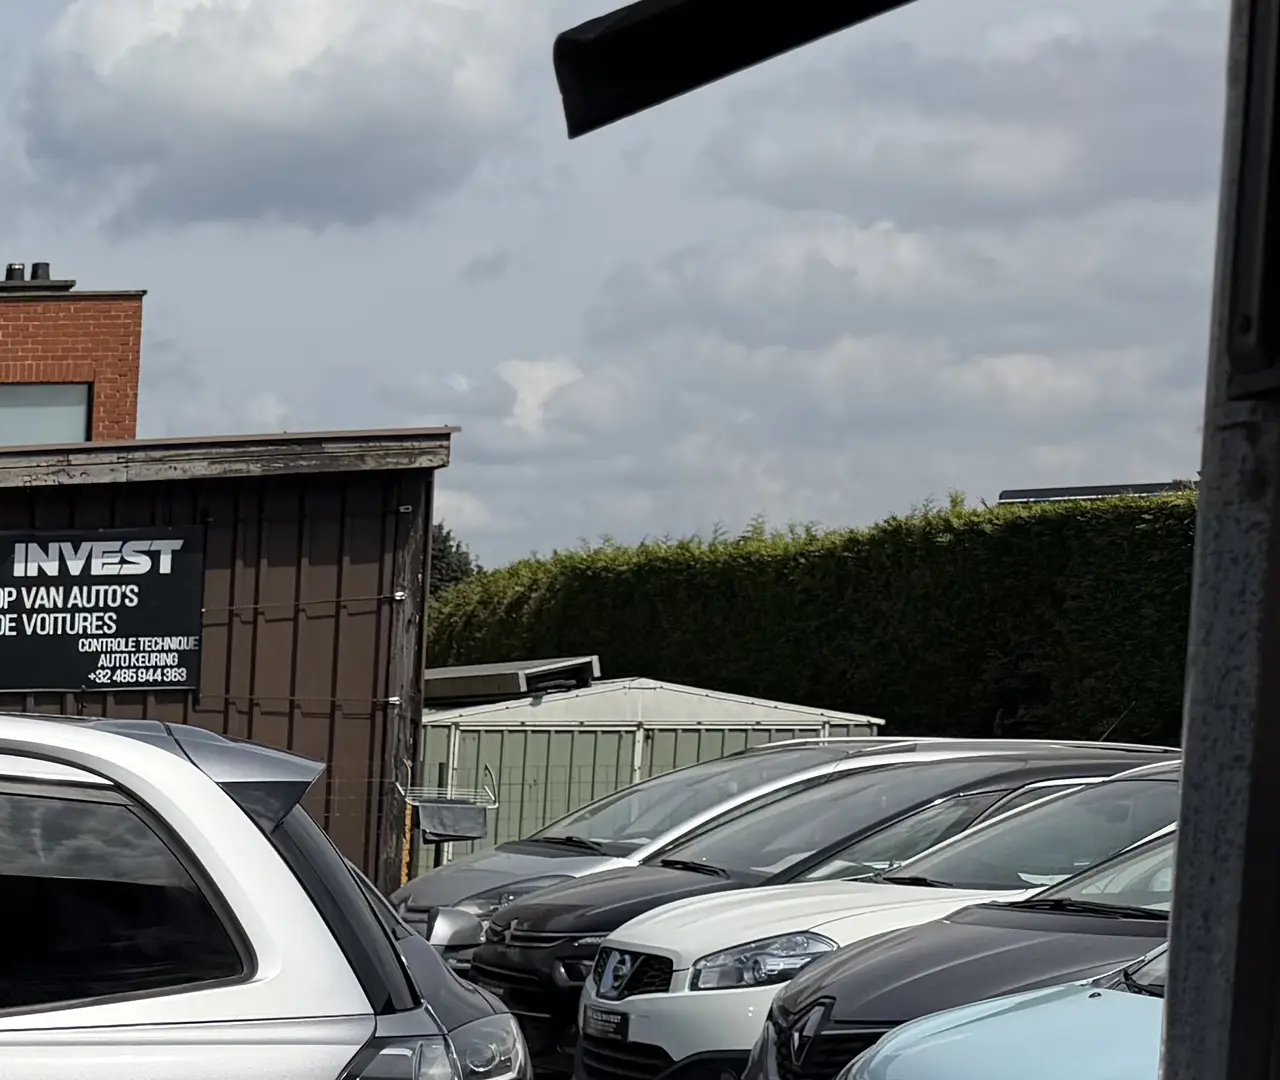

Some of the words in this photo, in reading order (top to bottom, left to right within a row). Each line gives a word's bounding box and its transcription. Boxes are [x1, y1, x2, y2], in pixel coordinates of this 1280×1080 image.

[12, 539, 185, 577] INVEST
[21, 586, 64, 609] VAN
[69, 584, 139, 609] AUTO'S
[22, 612, 117, 635] VOITURES
[78, 638, 137, 652] CONTROLE
[138, 636, 200, 651] TECHNIQUE
[98, 653, 130, 668] AUTO
[130, 652, 179, 667] KEURING
[88, 669, 111, 683] +32
[112, 668, 137, 683] 485
[137, 668, 162, 682] 944
[163, 668, 188, 682] 363
